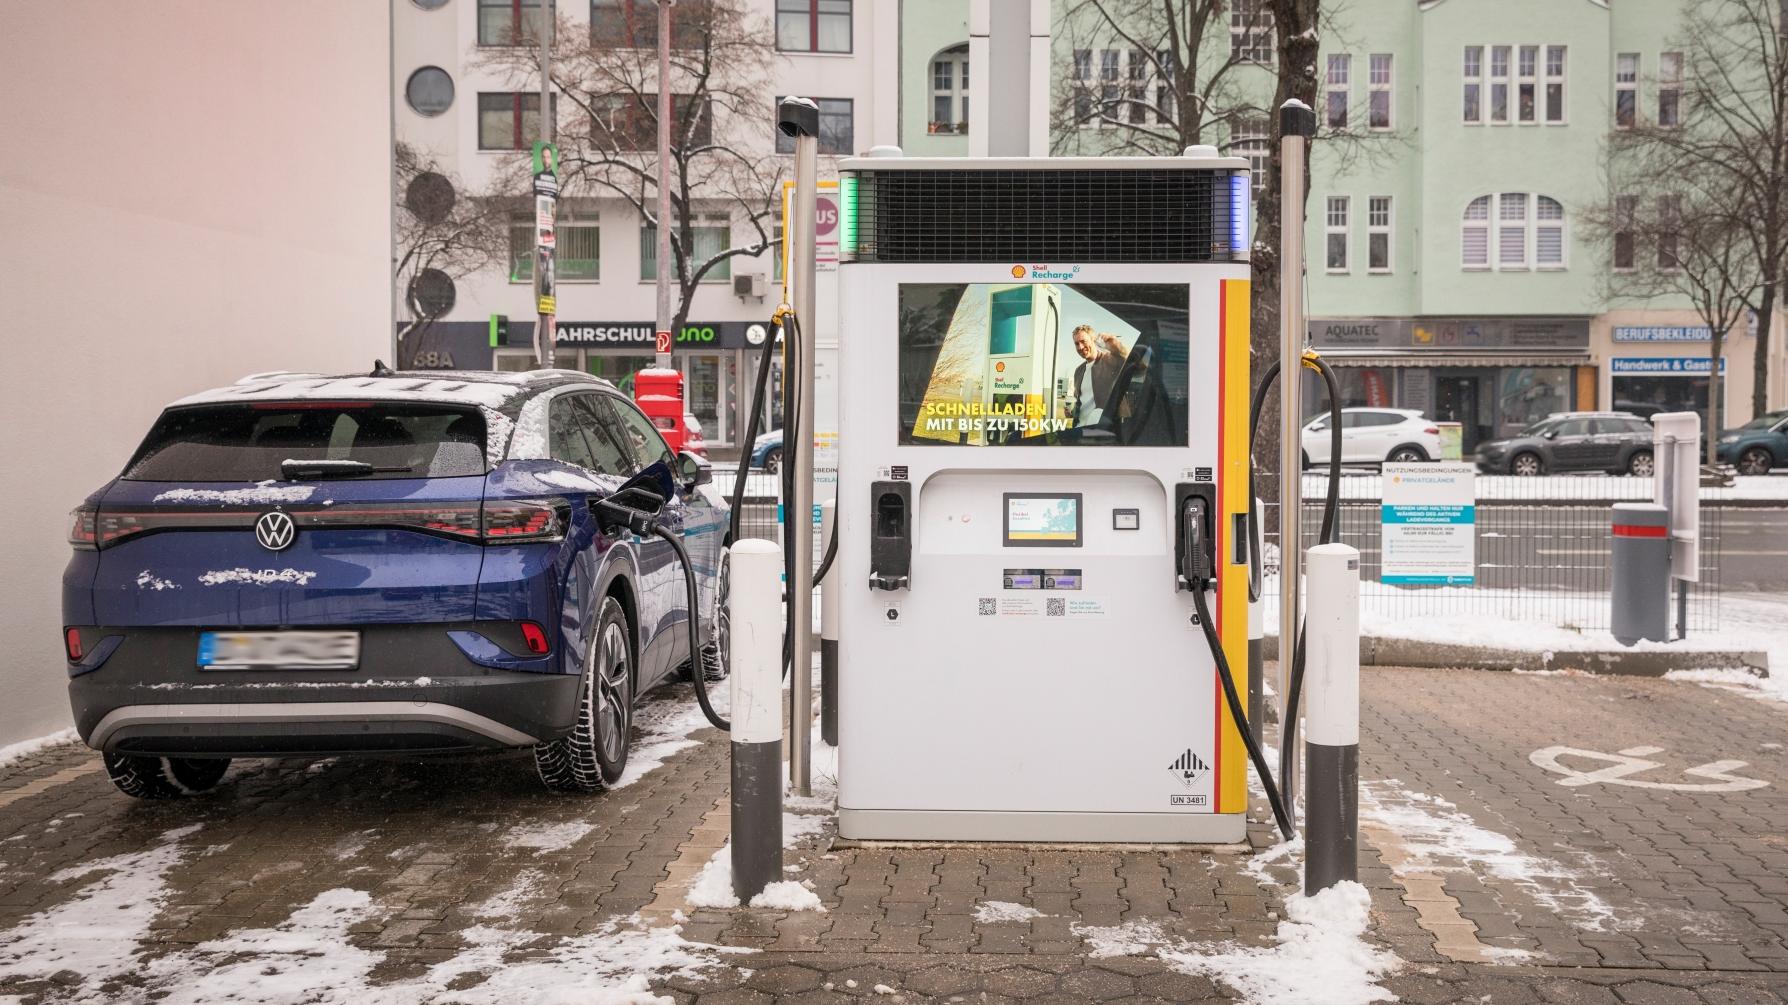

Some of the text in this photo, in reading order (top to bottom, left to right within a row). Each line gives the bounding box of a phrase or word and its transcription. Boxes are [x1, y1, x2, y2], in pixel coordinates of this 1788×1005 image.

[816, 209, 836, 224] US
[1032, 271, 1073, 280] Recharge
[556, 328, 657, 342] AHRSCHUL
[1325, 325, 1378, 338] AQUATEC
[1615, 328, 1727, 341] BERUFSBEKLEIDU
[1615, 360, 1723, 371] Handwerk & Gast
[926, 402, 1047, 416] SCHNELLLADEN
[926, 418, 1068, 431] MIT BIS ZU 150KW
